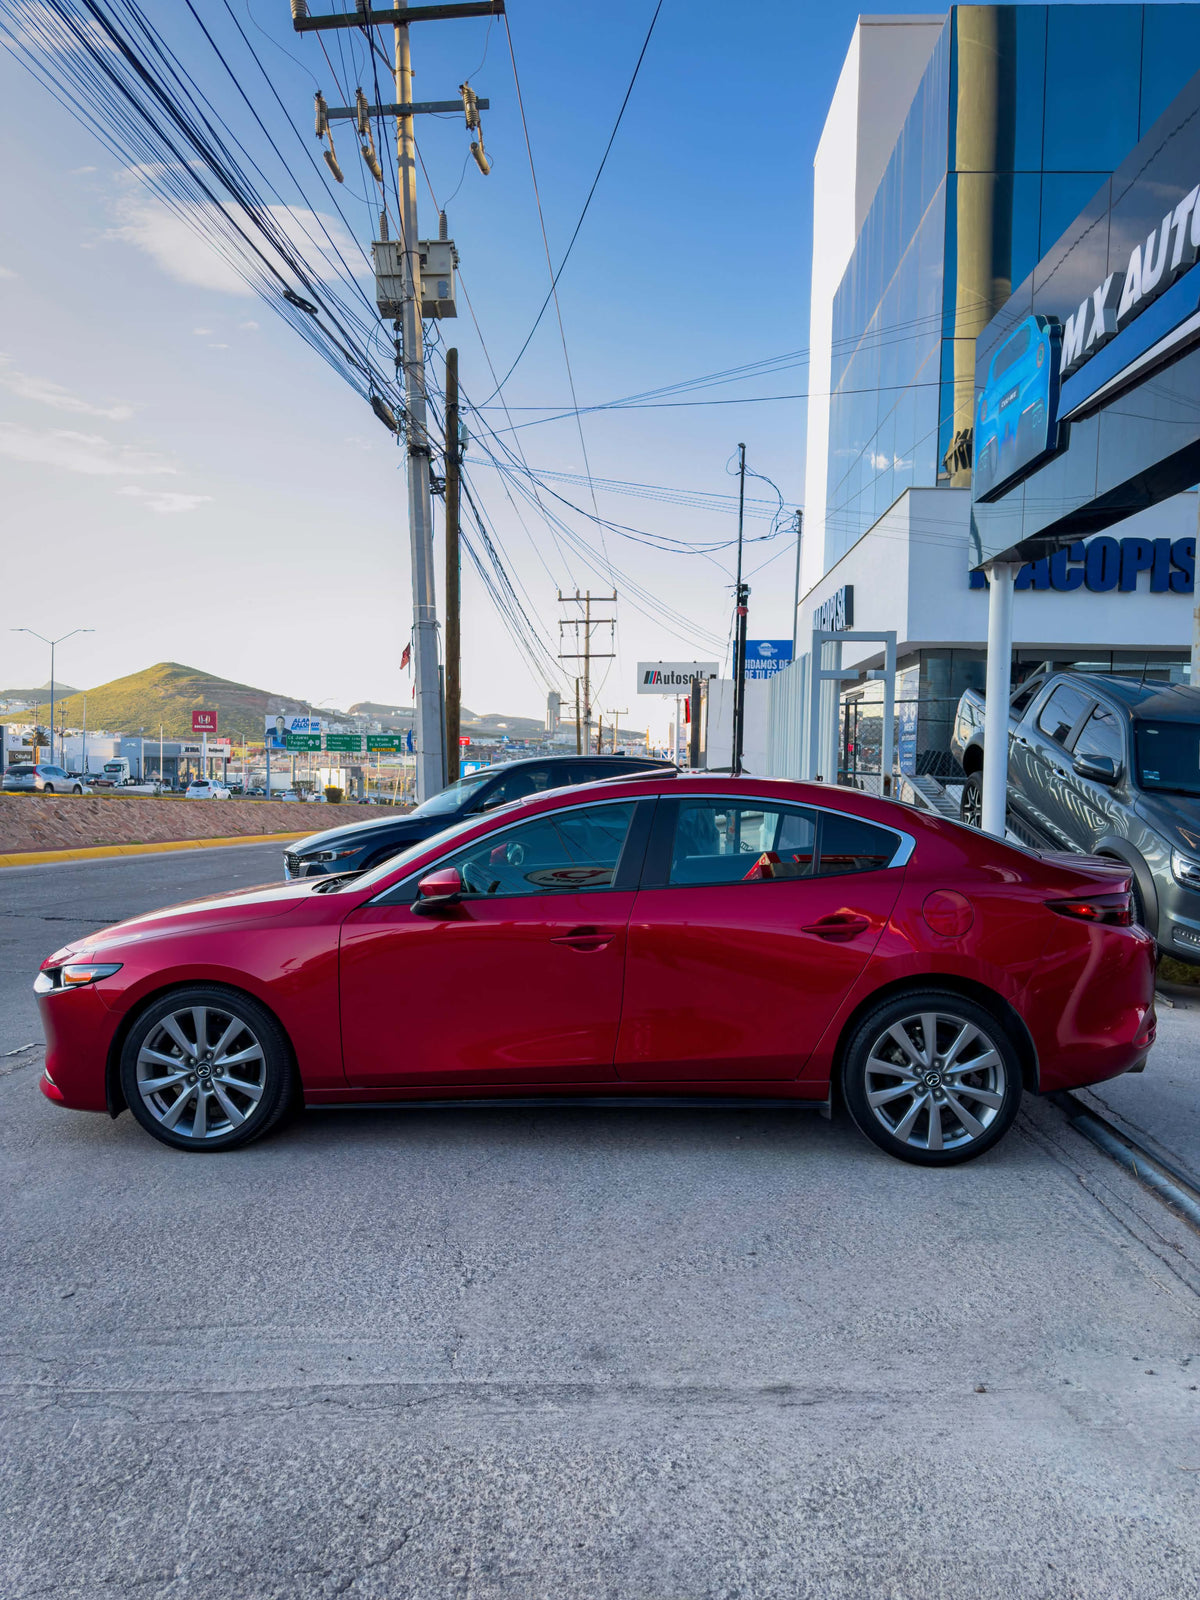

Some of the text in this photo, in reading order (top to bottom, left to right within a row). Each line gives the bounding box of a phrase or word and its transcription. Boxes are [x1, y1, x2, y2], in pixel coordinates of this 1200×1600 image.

[1060, 183, 1200, 375] MX AUT
[969, 536, 1195, 593] ACOPIS
[755, 670, 765, 679] TU
[767, 670, 779, 679] FA
